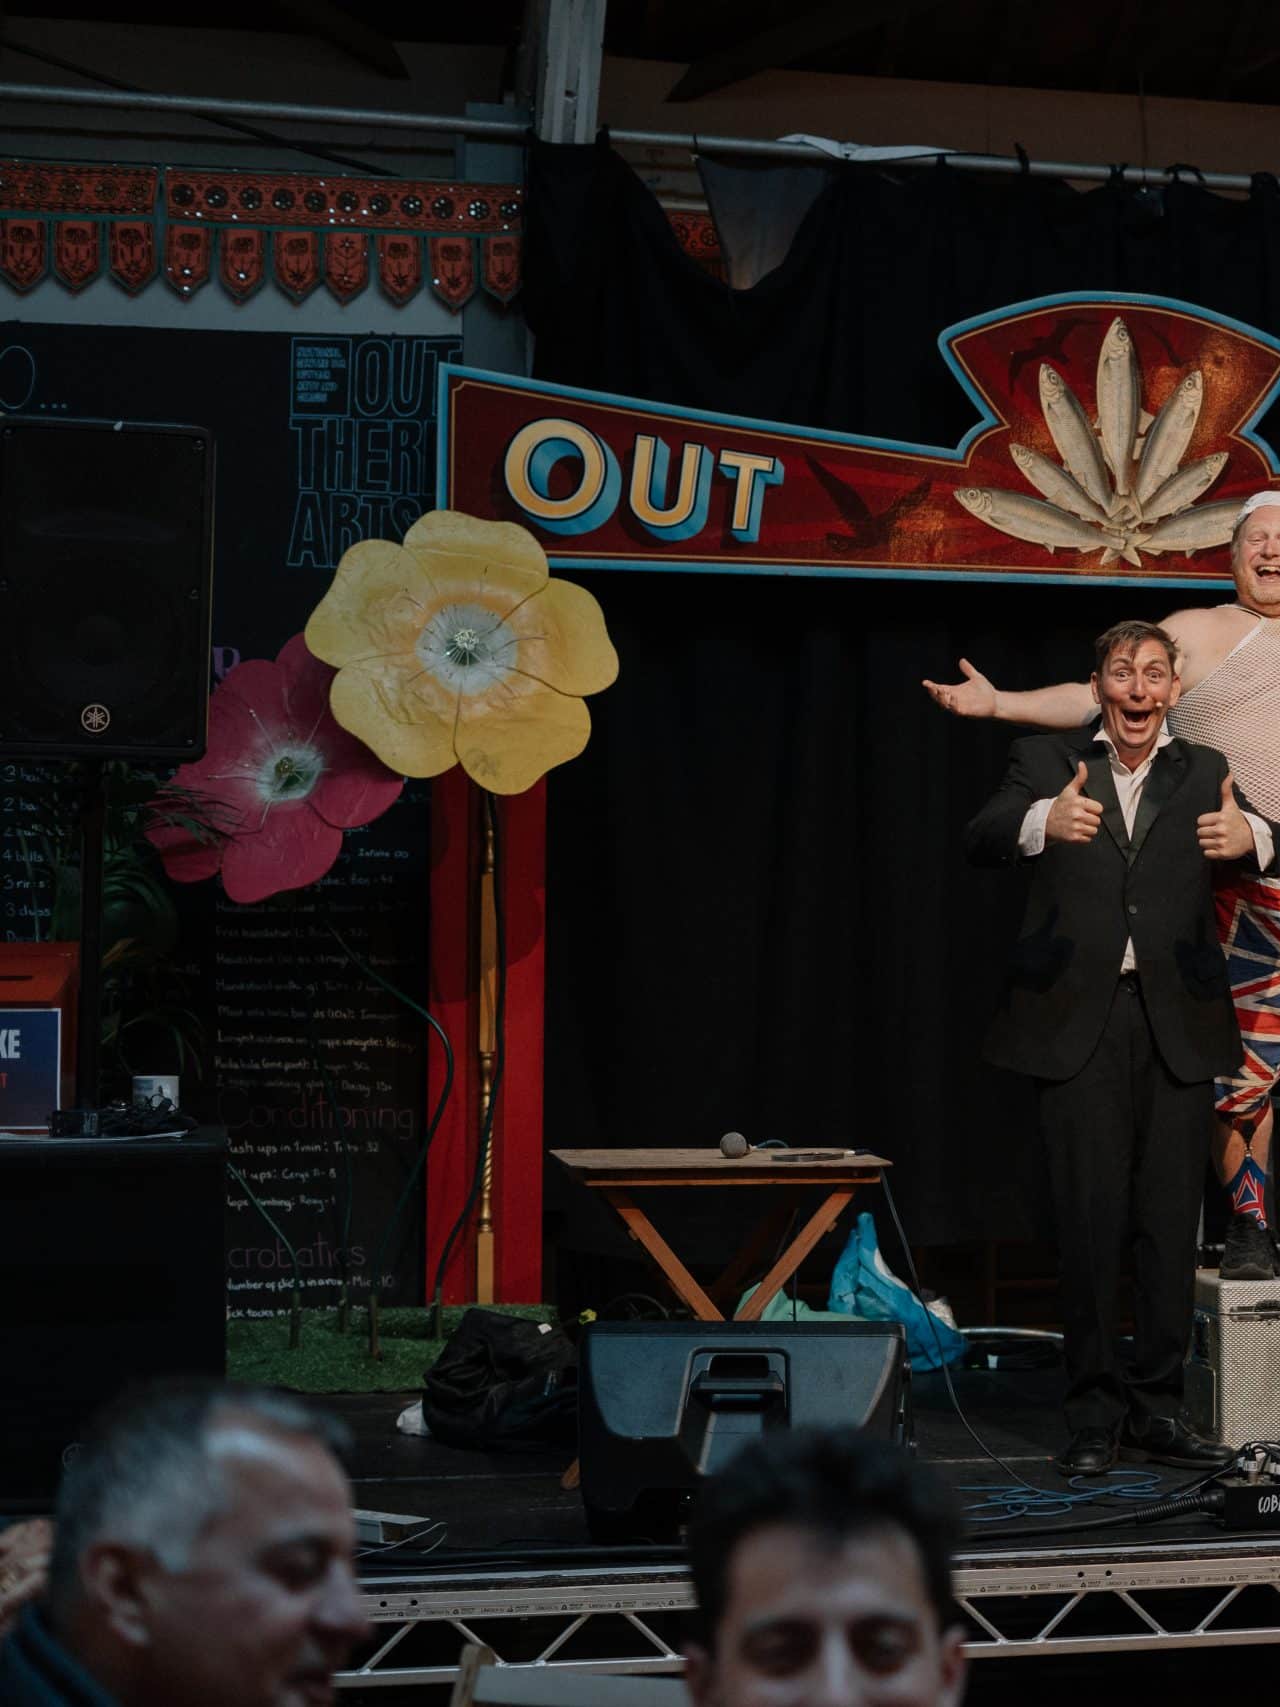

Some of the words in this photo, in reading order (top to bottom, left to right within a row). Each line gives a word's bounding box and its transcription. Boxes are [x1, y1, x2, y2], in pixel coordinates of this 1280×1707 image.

[289, 418, 437, 495] THER
[504, 417, 785, 543] OUT
[217, 1086, 415, 1142] Conditioning
[227, 1231, 367, 1269] crobatics
